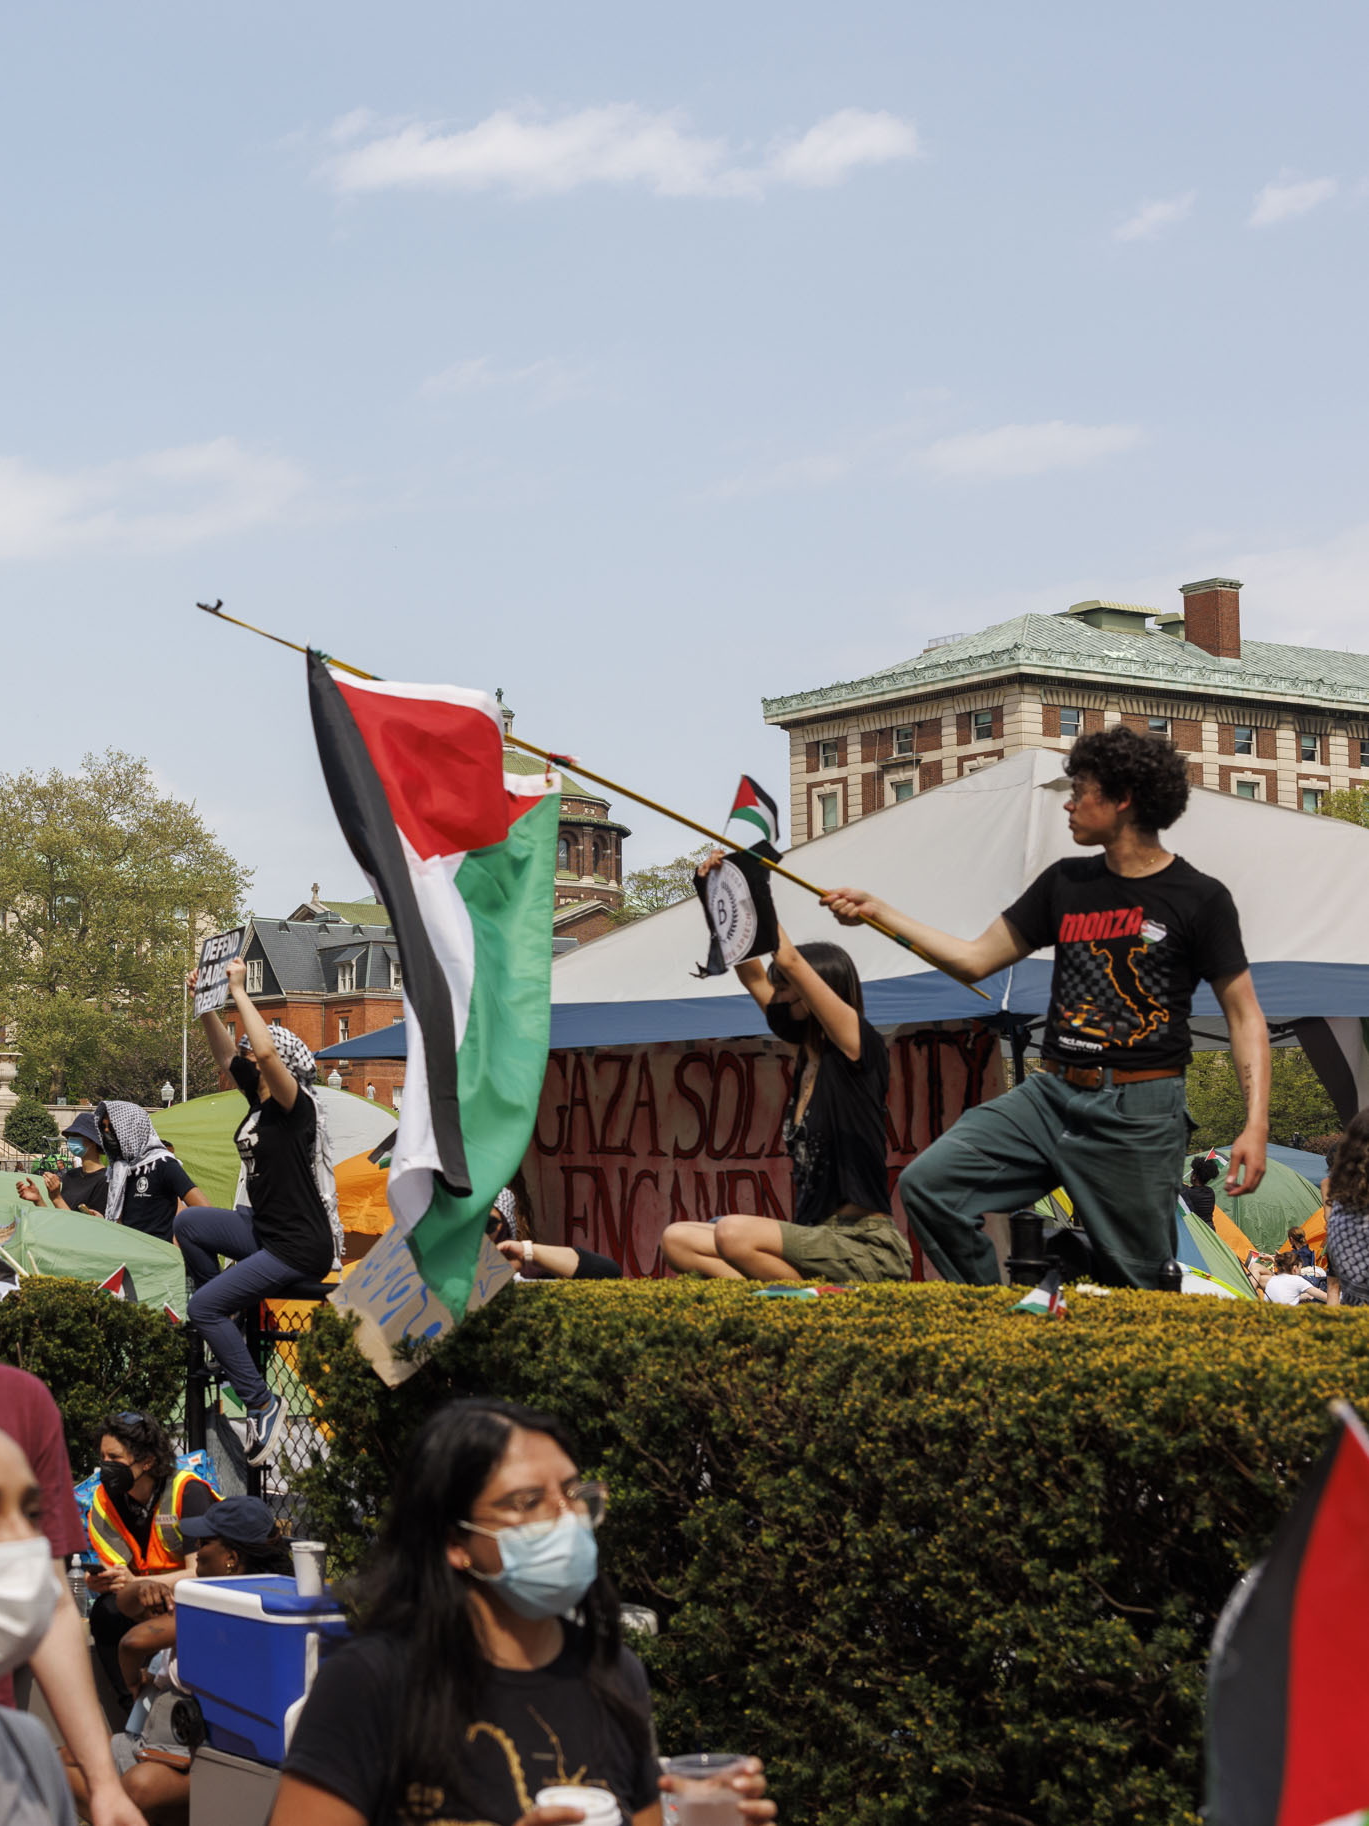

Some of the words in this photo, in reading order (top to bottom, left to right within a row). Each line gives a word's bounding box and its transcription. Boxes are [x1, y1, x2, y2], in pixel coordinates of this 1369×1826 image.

[1058, 905, 1144, 943] MONZA
[203, 930, 240, 962] DEFEND
[534, 1051, 668, 1158] GAZA
